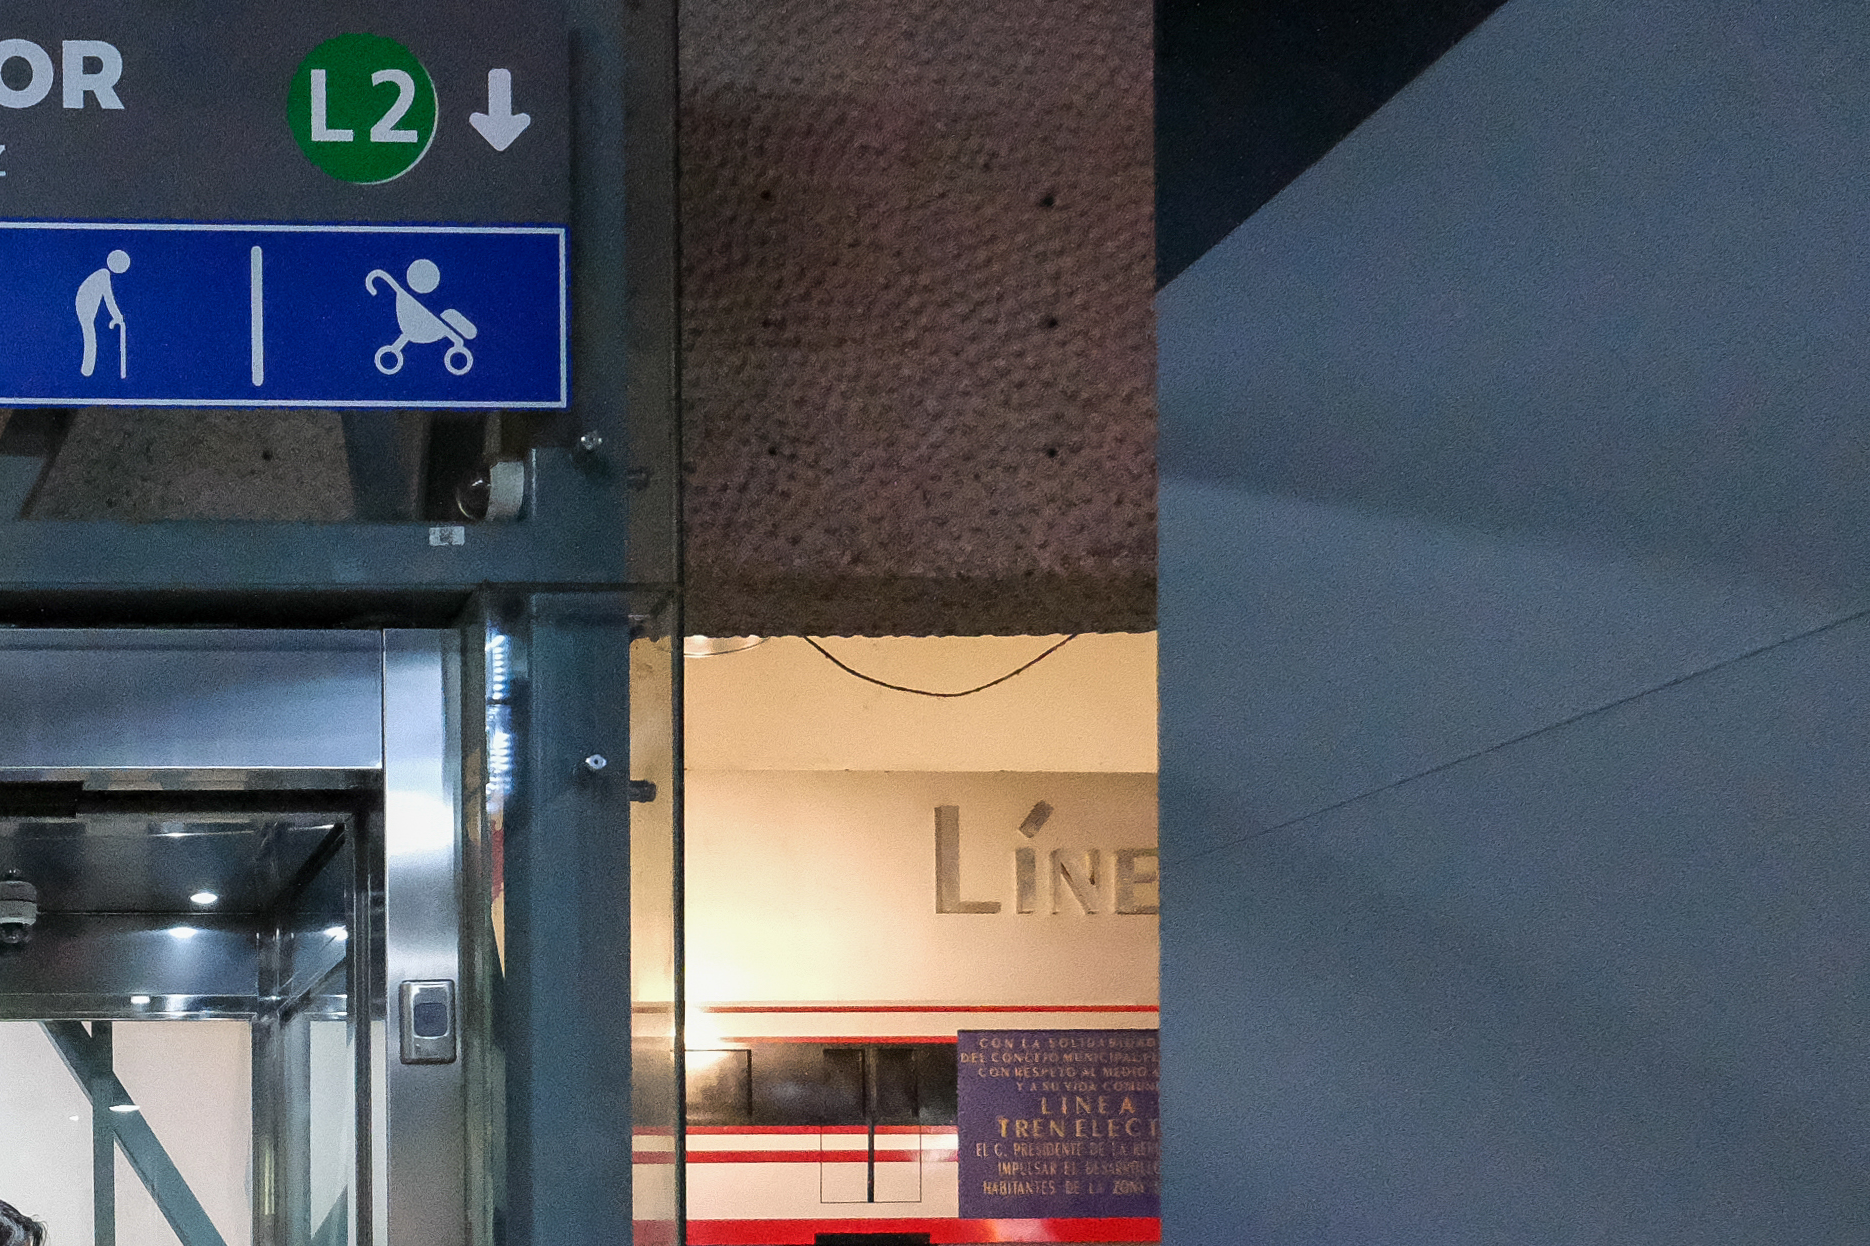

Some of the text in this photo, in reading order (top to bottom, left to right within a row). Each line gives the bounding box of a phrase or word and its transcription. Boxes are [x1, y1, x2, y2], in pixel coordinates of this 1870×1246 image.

[978, 1037, 1014, 1049] CON
[1020, 1037, 1040, 1049] LA
[977, 1066, 1010, 1078] CON
[1040, 1096, 1136, 1115] LINEA
[998, 1117, 1066, 1138] TREN
[975, 1143, 989, 1157] EL
